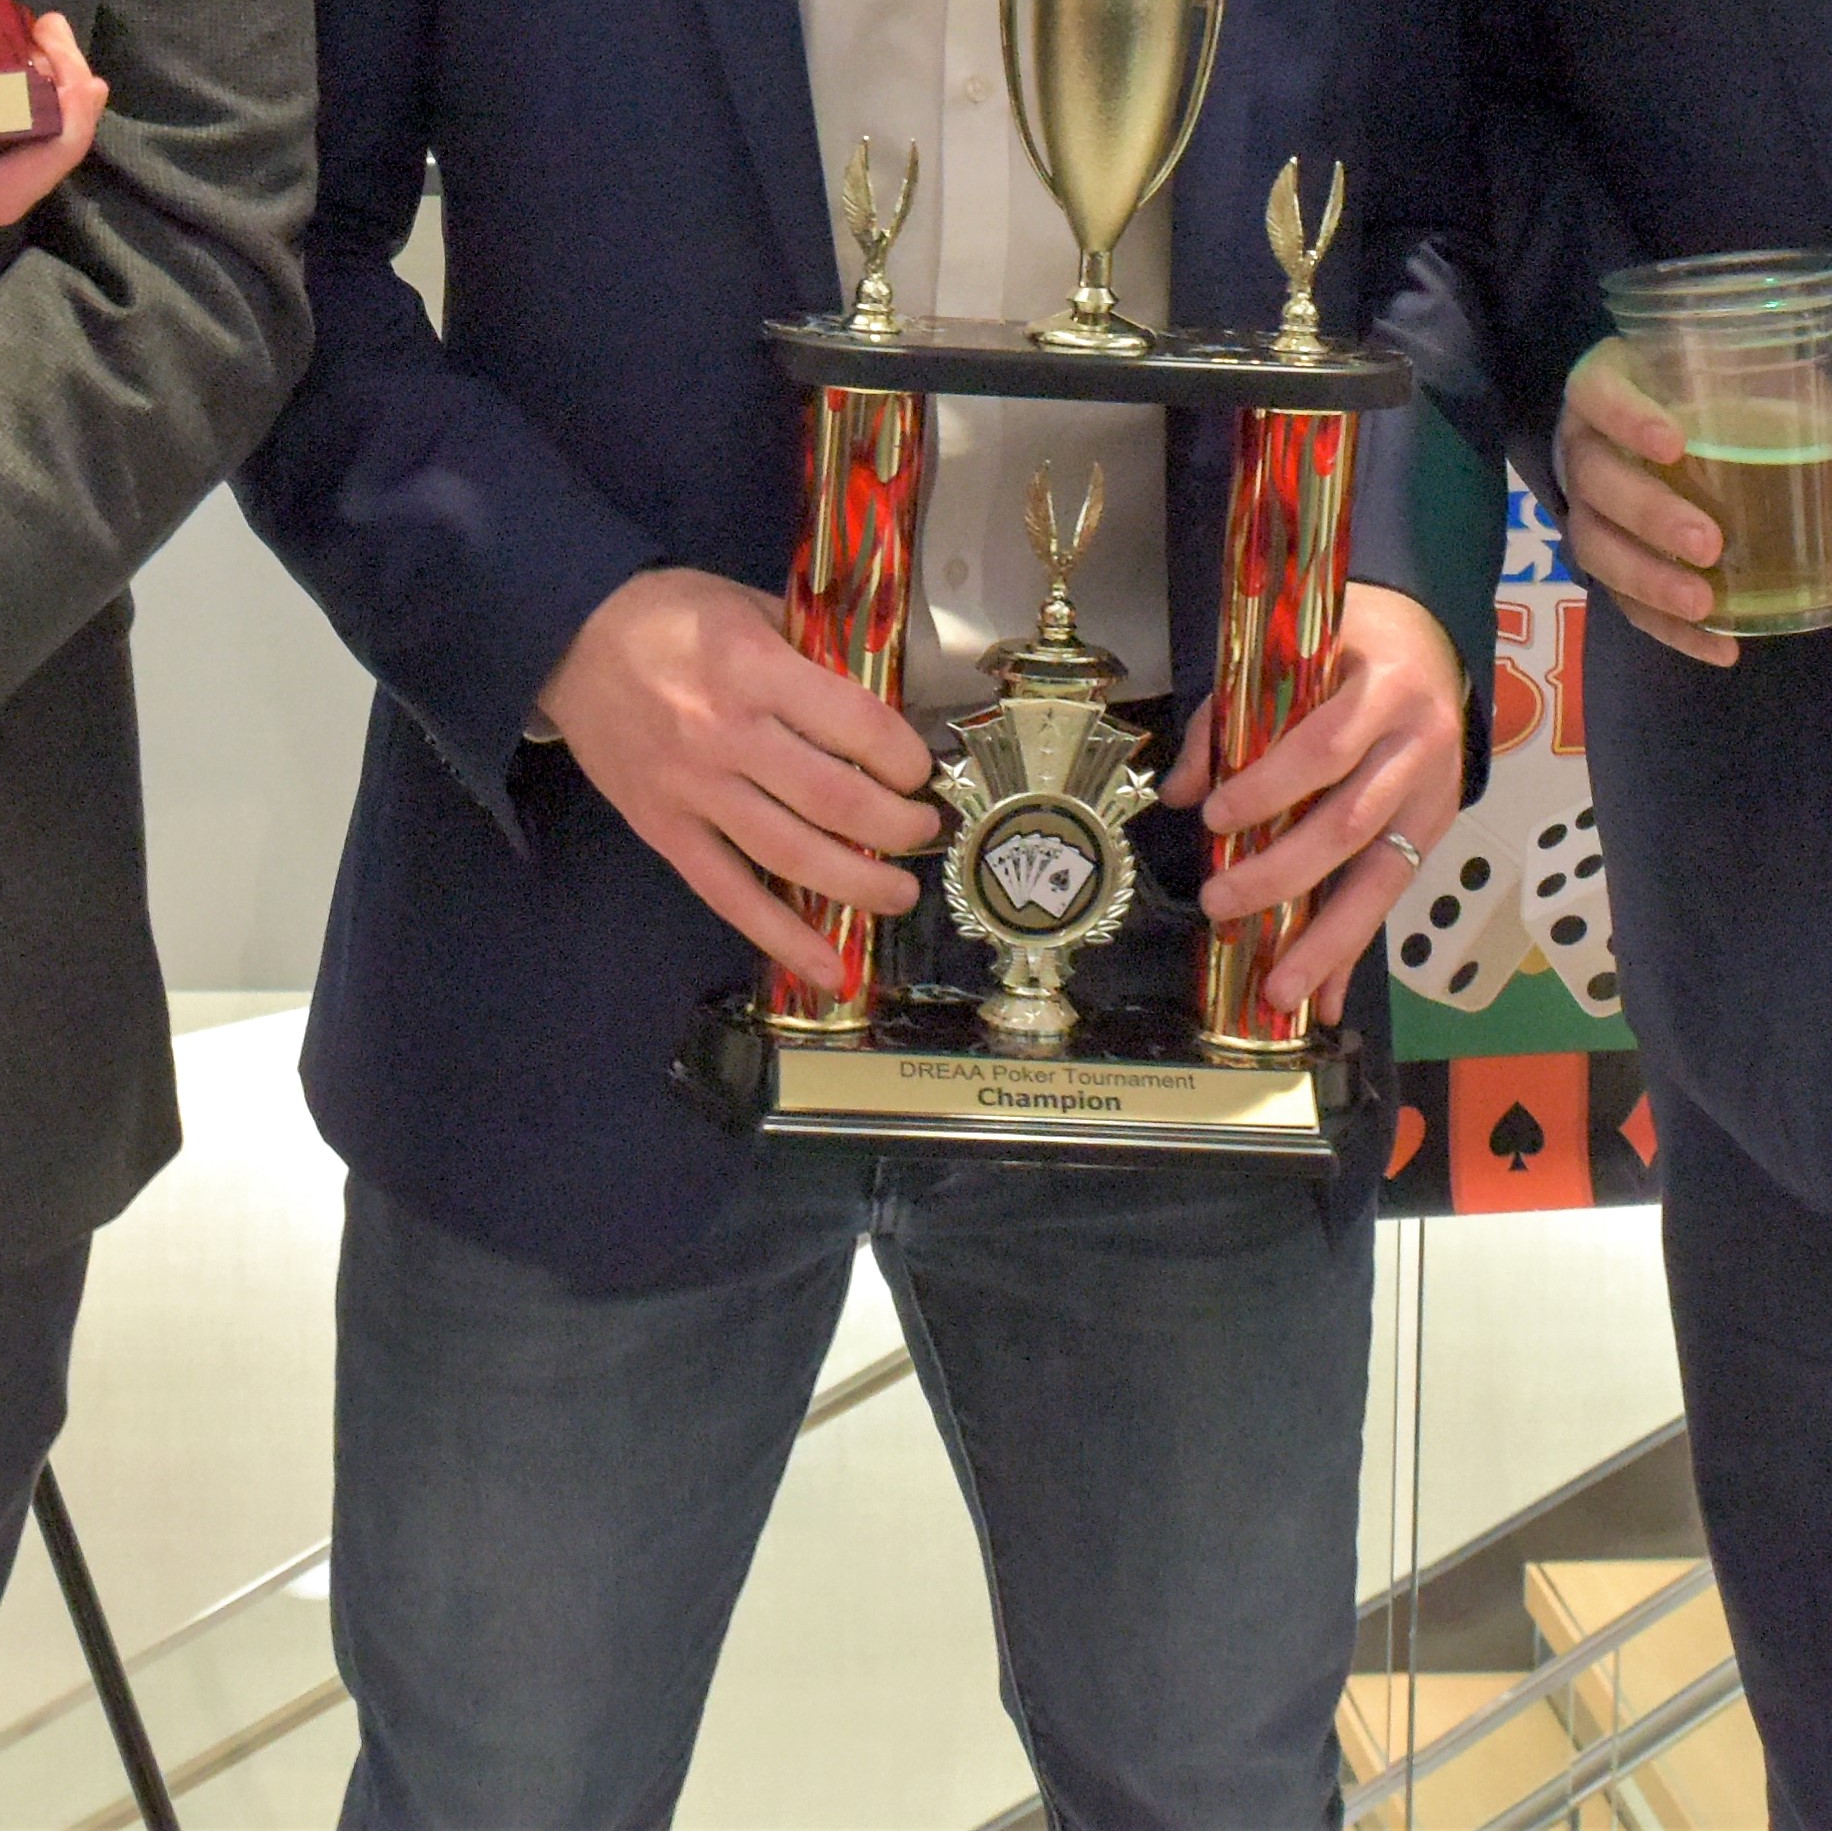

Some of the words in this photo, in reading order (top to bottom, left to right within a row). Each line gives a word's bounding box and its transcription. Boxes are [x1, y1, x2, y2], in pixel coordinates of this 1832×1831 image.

[900, 1061, 985, 1081] DREAA
[992, 1066, 1056, 1085] Poker
[1065, 1068, 1197, 1090] Tournament
[977, 1086, 1122, 1113] Champion
